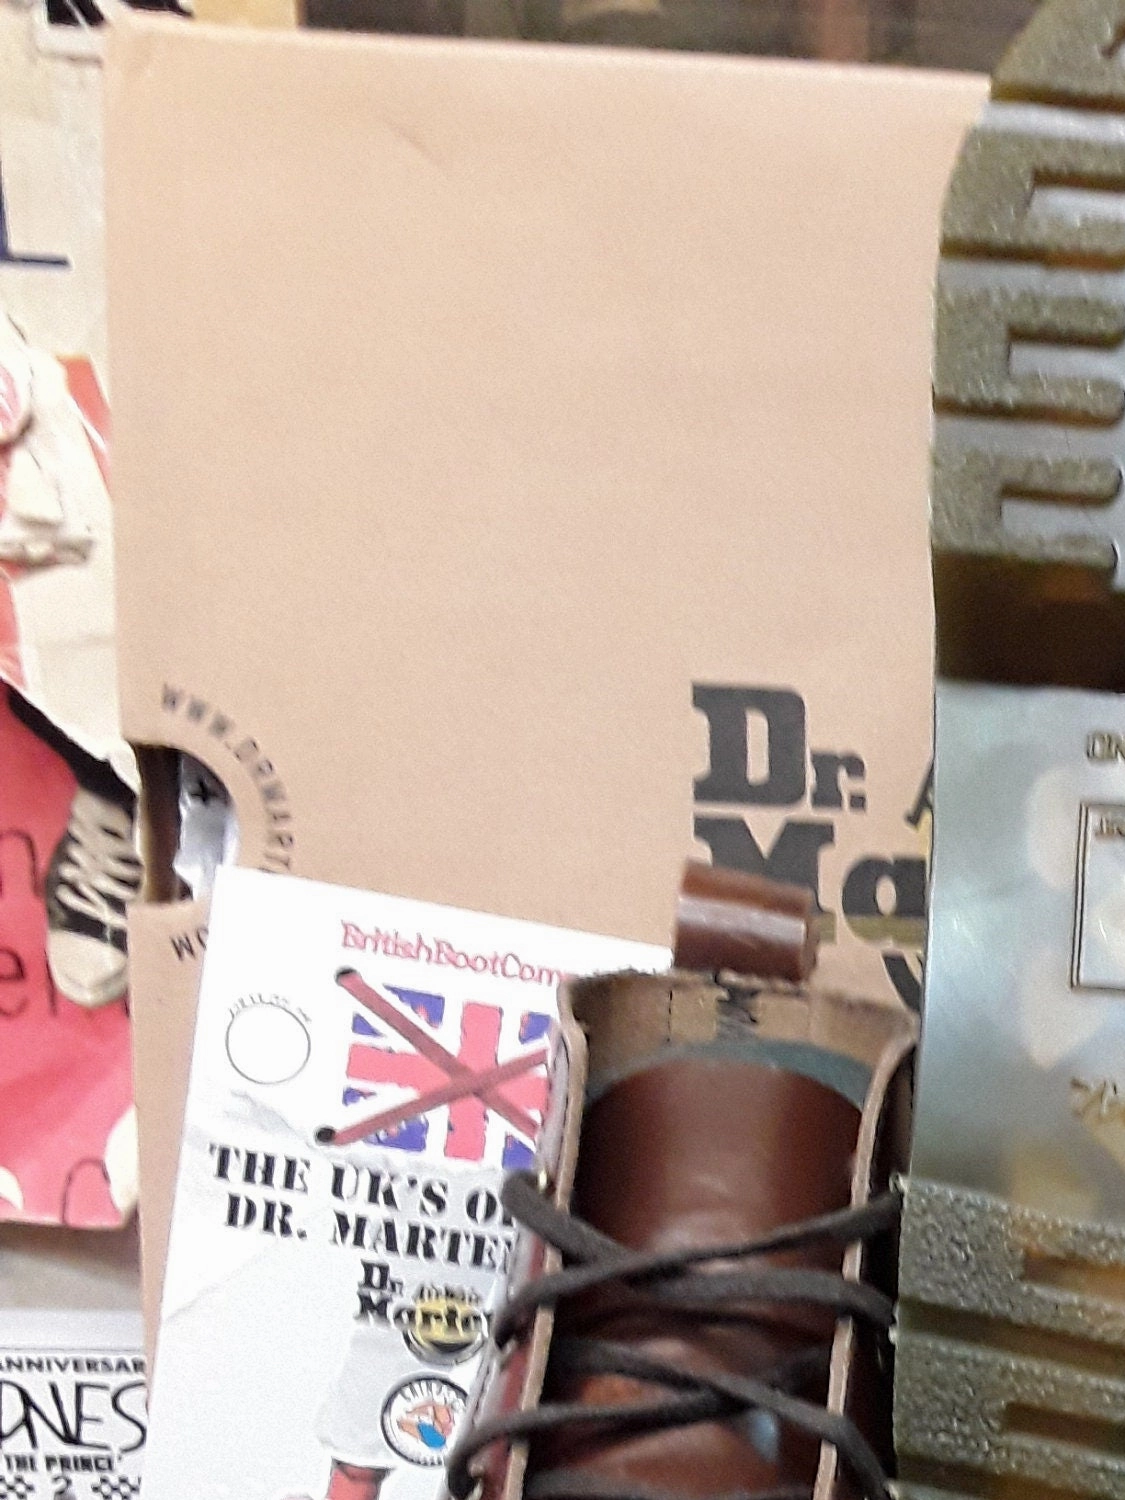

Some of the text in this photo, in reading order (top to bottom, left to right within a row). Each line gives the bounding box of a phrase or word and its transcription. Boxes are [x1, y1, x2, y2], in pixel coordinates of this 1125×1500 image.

[691, 681, 867, 812] Dr.
[693, 815, 930, 946] Ma
[340, 919, 563, 985] BritishBootCom
[209, 1142, 312, 1195] THE
[331, 1162, 450, 1217] UK'S
[225, 1192, 309, 1240] DR.
[0, 1356, 146, 1375] NNIVERSAR
